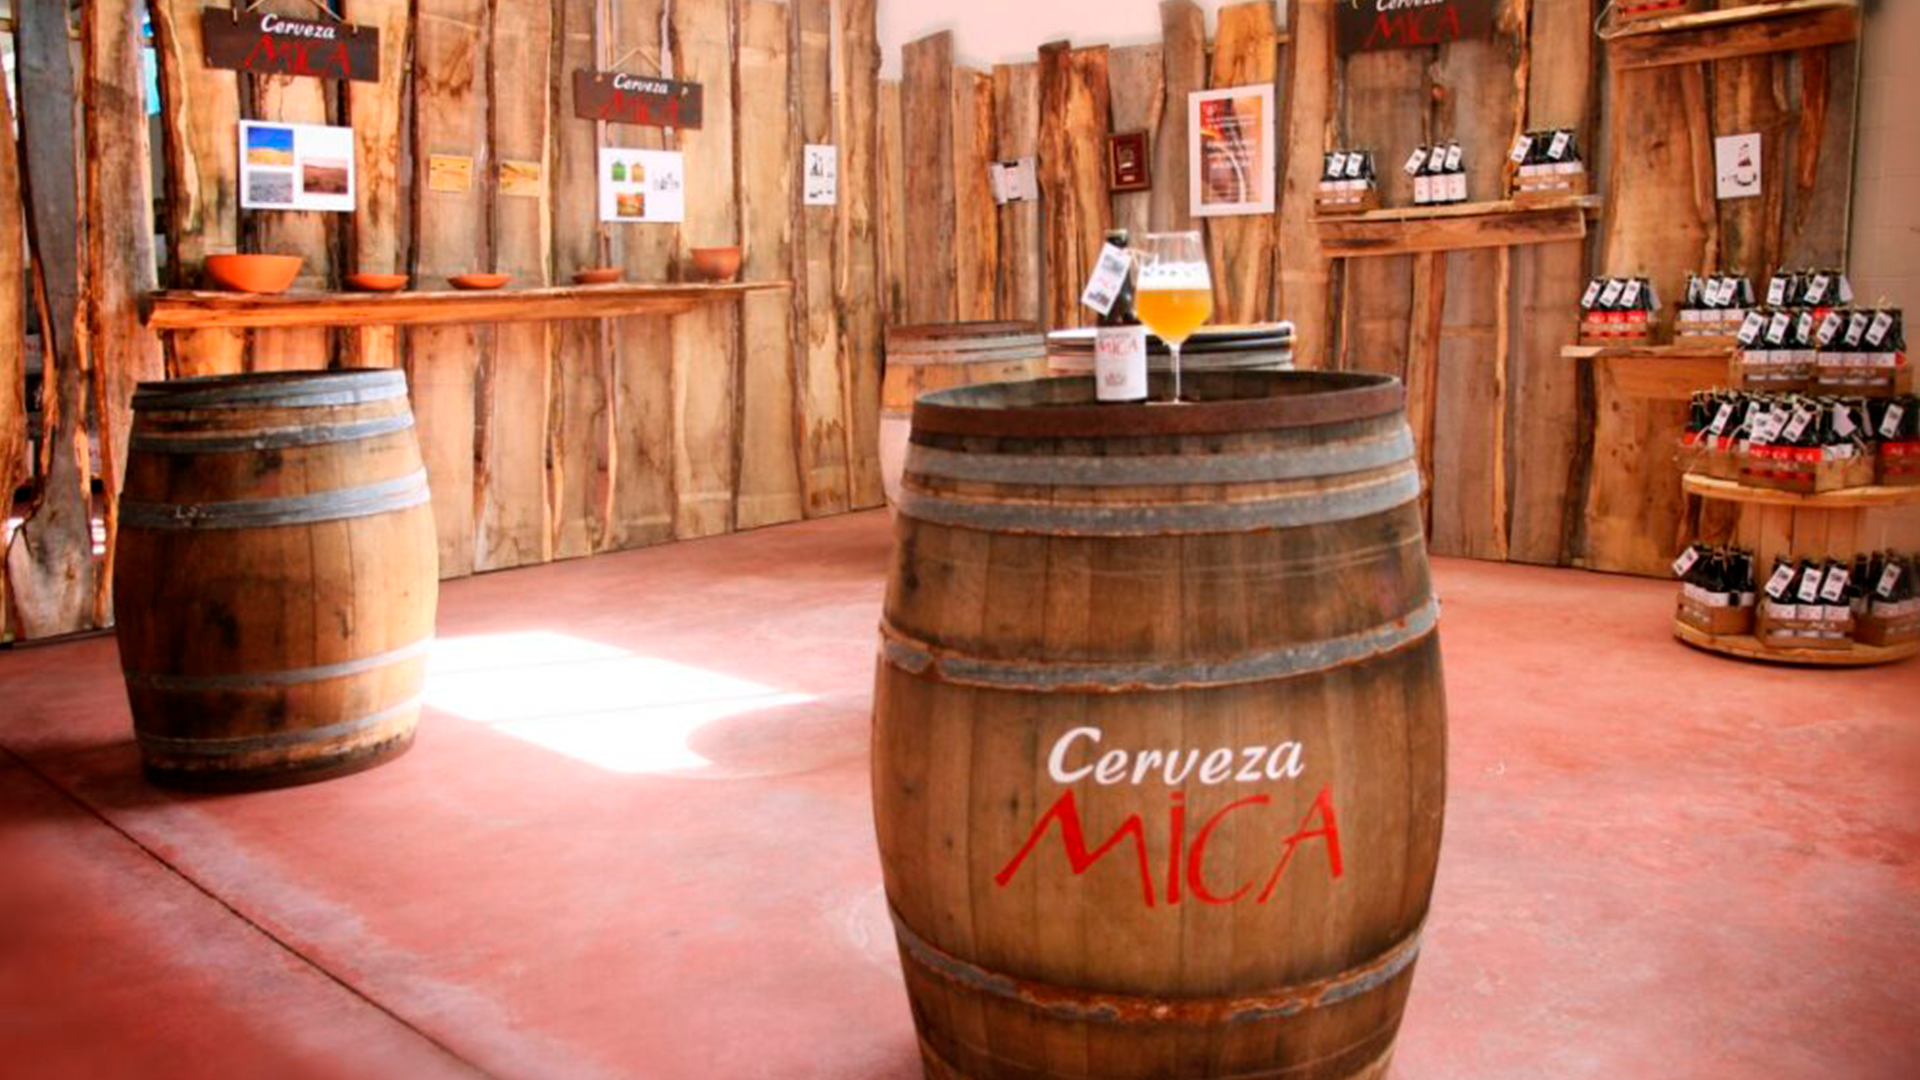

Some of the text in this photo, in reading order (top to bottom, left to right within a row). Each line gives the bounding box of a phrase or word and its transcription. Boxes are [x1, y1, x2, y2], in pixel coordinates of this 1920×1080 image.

[261, 13, 337, 39] Cerveza
[613, 73, 668, 94] Cerveza
[1048, 726, 1305, 785] Cerveza
